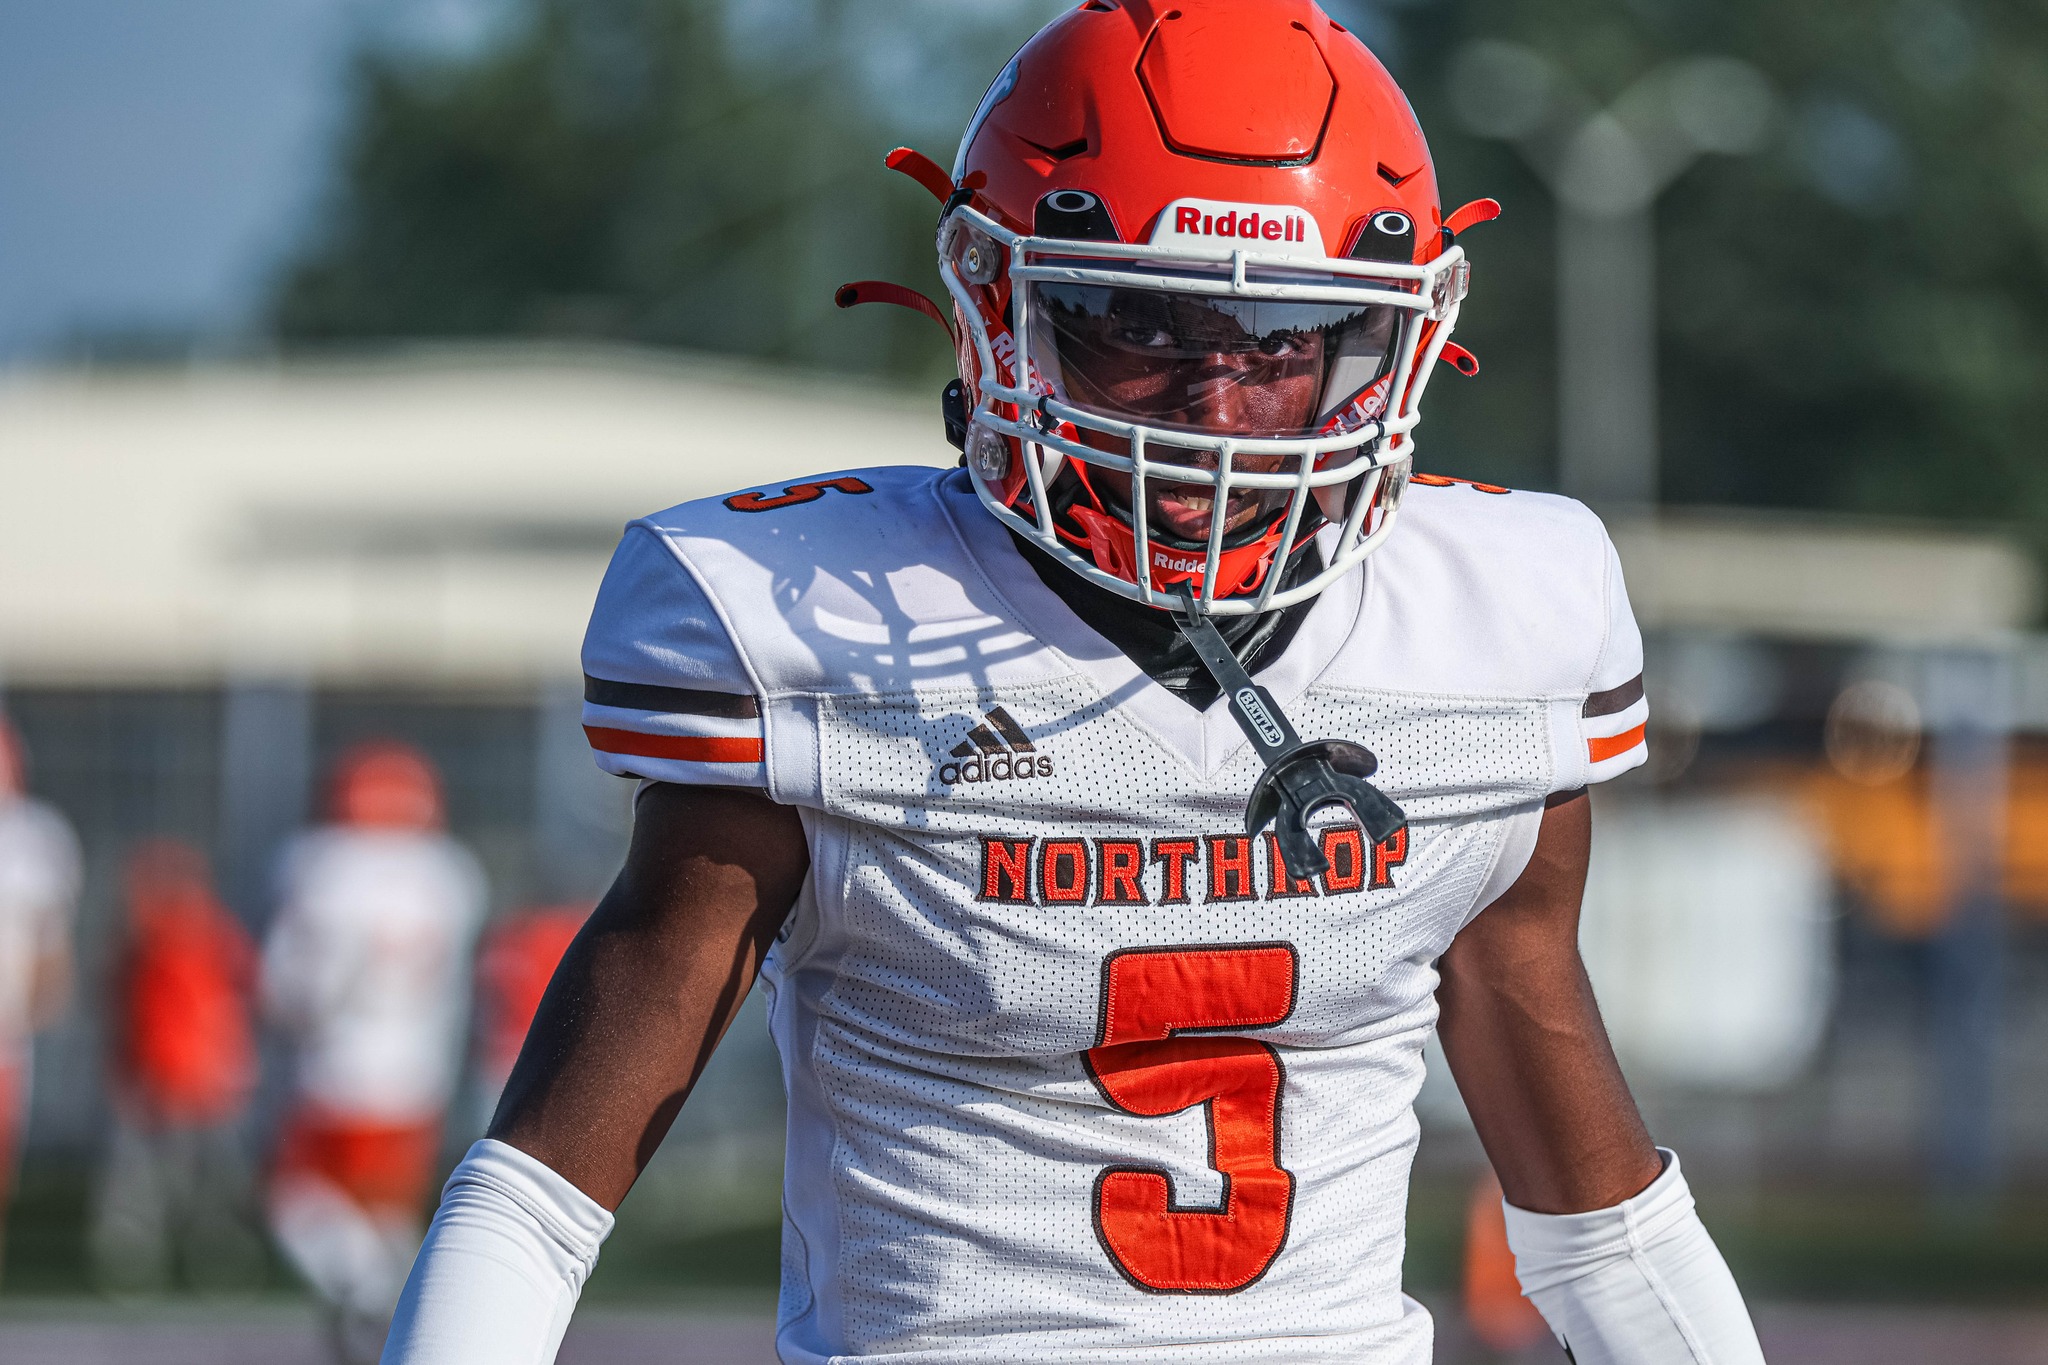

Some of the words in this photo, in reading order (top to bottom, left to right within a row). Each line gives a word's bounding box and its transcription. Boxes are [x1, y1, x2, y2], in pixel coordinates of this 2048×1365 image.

[1176, 206, 1305, 242] Riddell
[1316, 379, 1392, 440] ddell
[723, 476, 874, 512] 5
[1154, 552, 1219, 573] Ridde
[1240, 692, 1281, 743] BATTLE
[939, 751, 1054, 785] adidas
[1081, 940, 1300, 1295] 5
